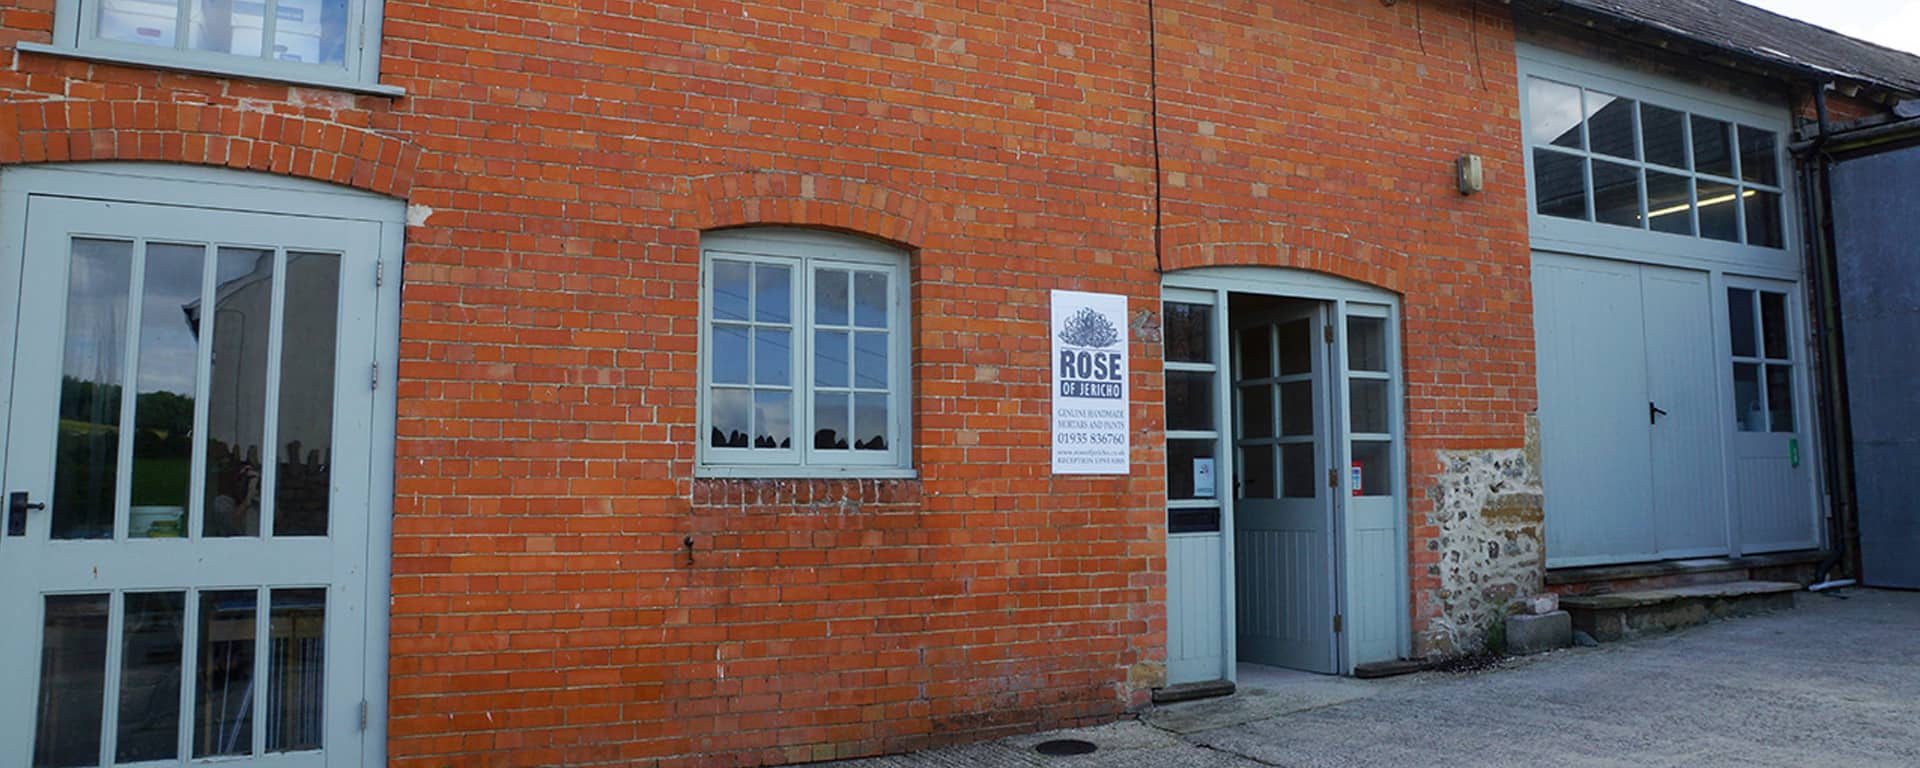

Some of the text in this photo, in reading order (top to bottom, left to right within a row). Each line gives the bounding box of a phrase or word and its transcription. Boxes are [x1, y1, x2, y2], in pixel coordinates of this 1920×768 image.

[1060, 350, 1121, 380] ROSE
[1063, 382, 1120, 397] OF JERICHO
[1088, 420, 1103, 429] AND
[1057, 433, 1125, 445] 01935 836760
